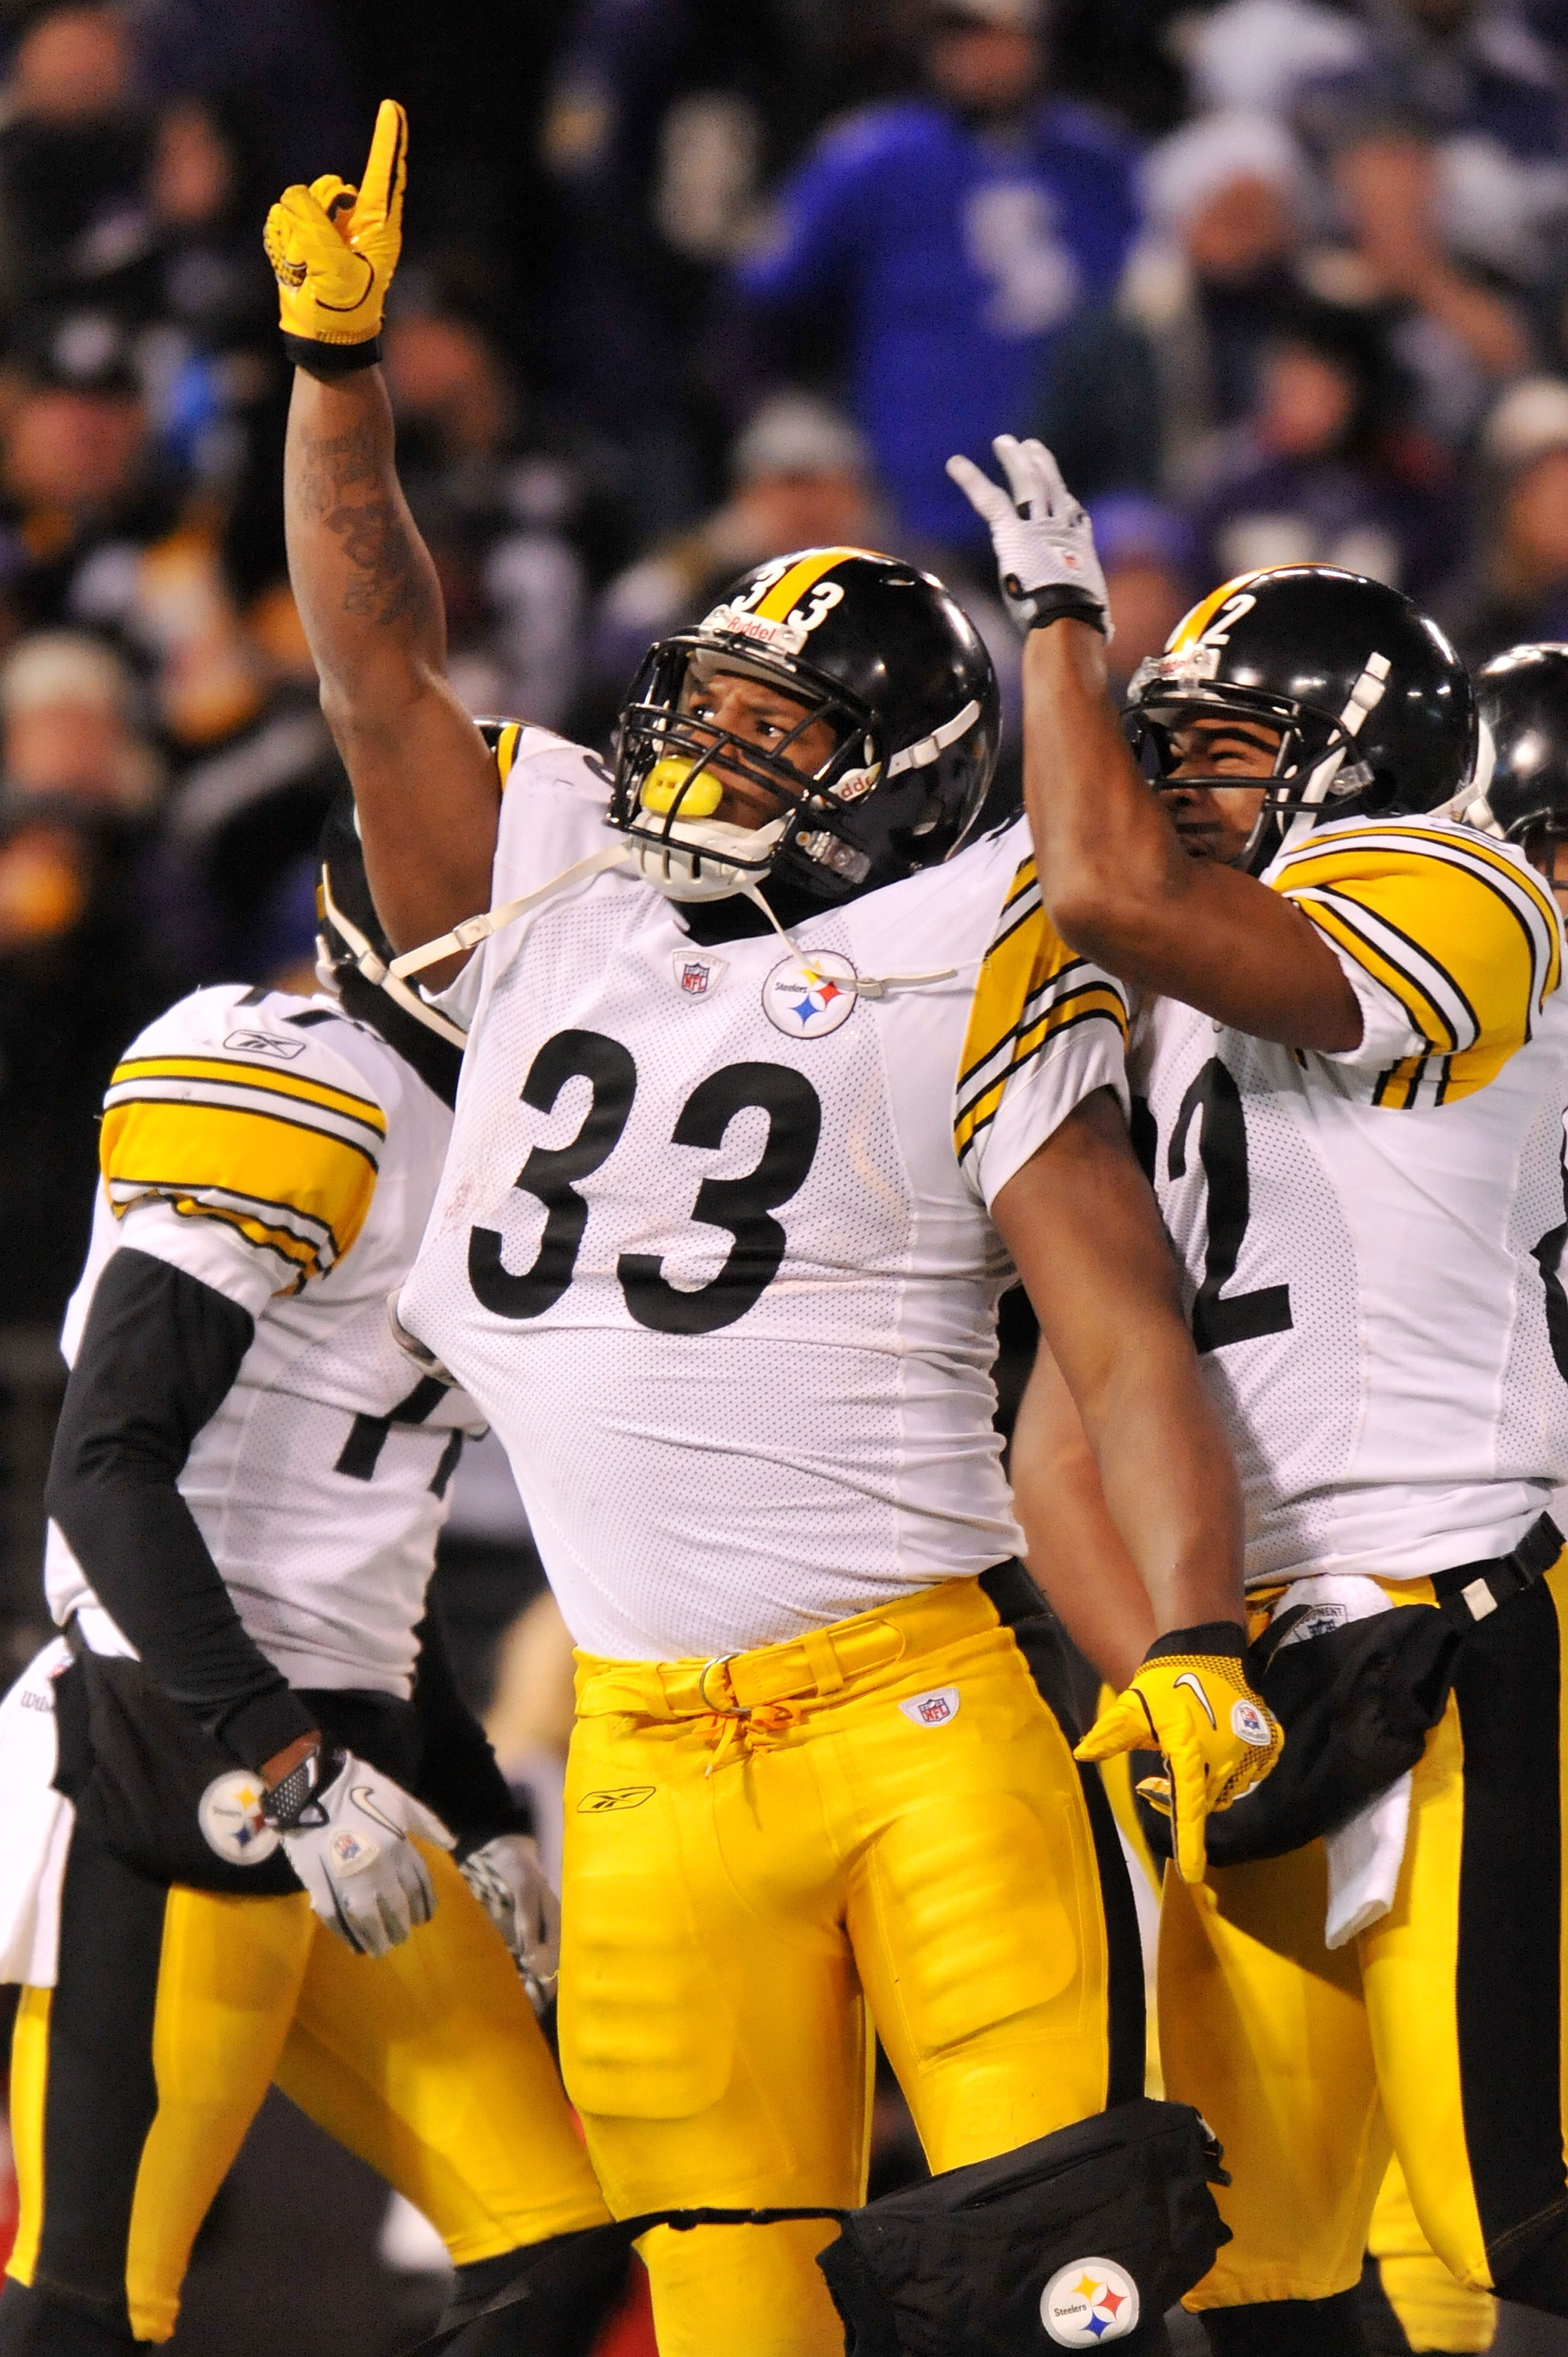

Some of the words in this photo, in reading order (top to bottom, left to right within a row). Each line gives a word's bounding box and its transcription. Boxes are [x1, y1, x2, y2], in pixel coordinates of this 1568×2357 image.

[775, 982, 808, 994] Steelers
[468, 1028, 822, 1335] 33
[1131, 1057, 1294, 1355] 2
[923, 1705, 948, 1721] NFL
[1054, 2303, 1087, 2318] Steelers
